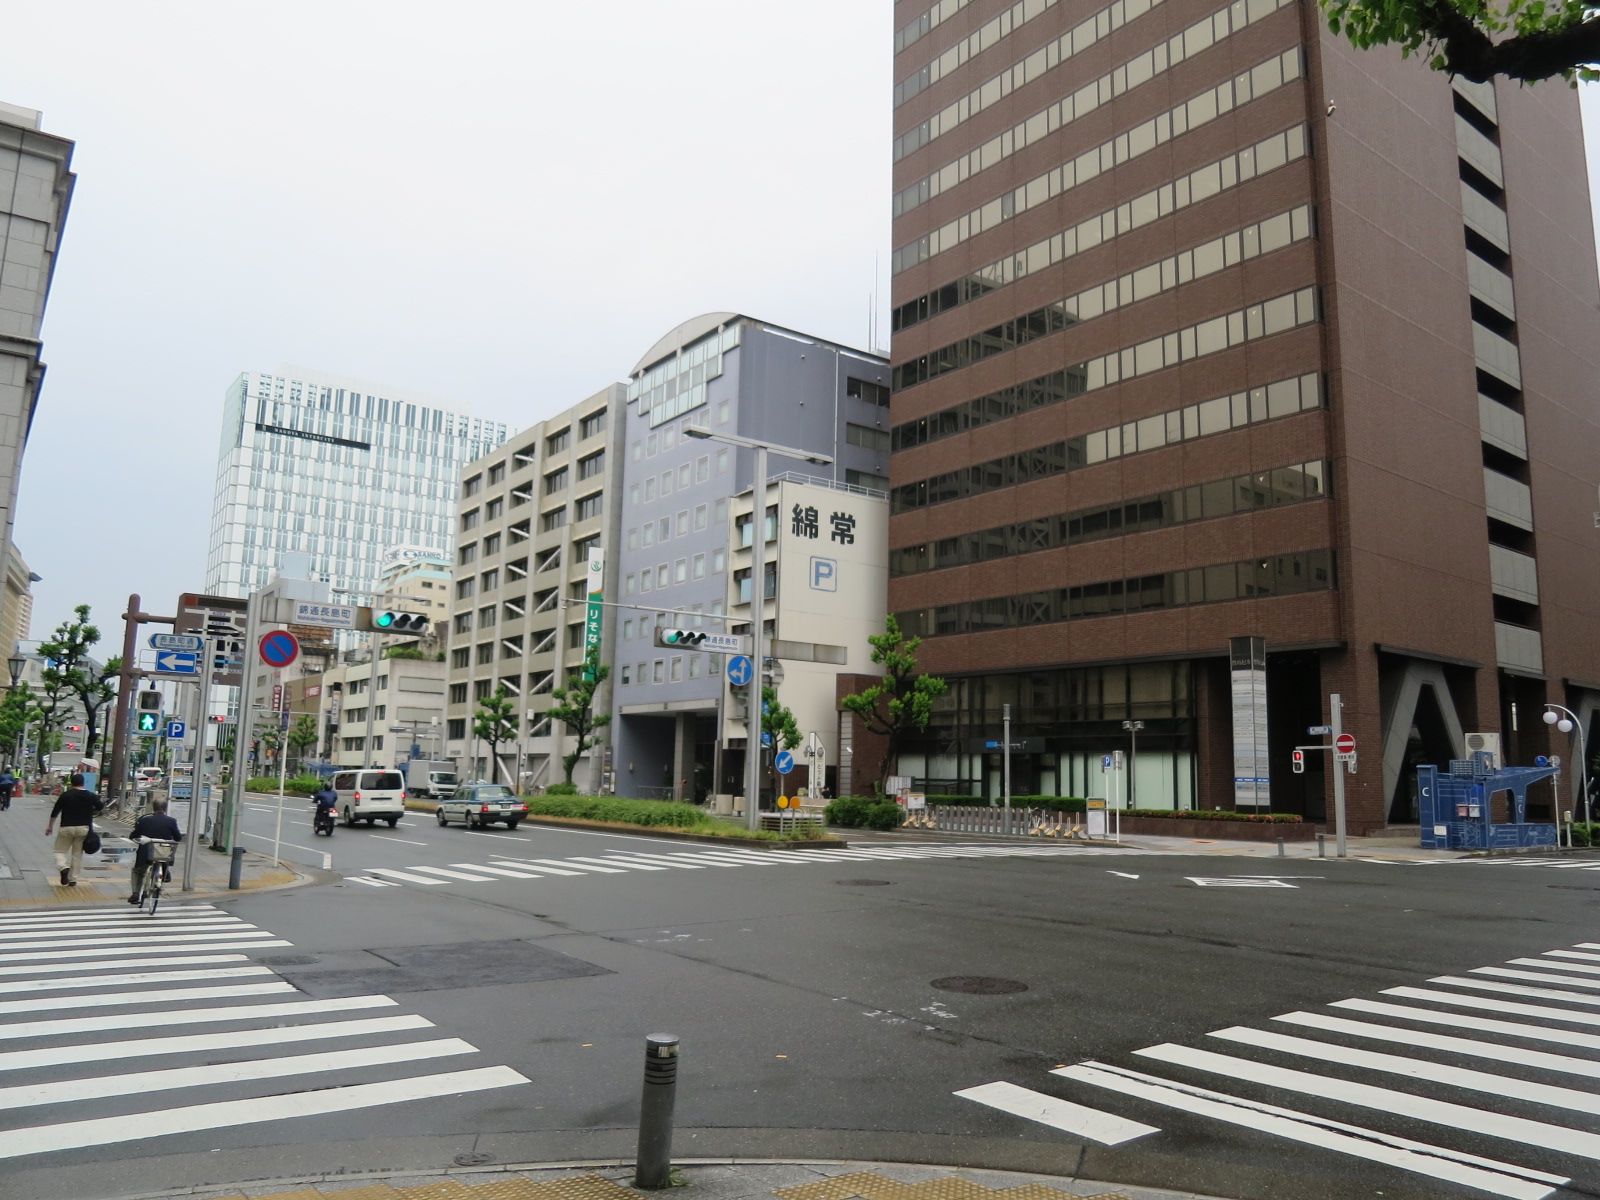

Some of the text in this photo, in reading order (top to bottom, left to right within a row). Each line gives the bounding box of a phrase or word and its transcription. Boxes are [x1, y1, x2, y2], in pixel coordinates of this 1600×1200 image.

[274, 427, 335, 443] NAGOYA INTERCITY
[792, 503, 856, 545] 綿常
[815, 561, 833, 587] P
[299, 605, 351, 619] 錦通長島町
[172, 723, 183, 737] P
